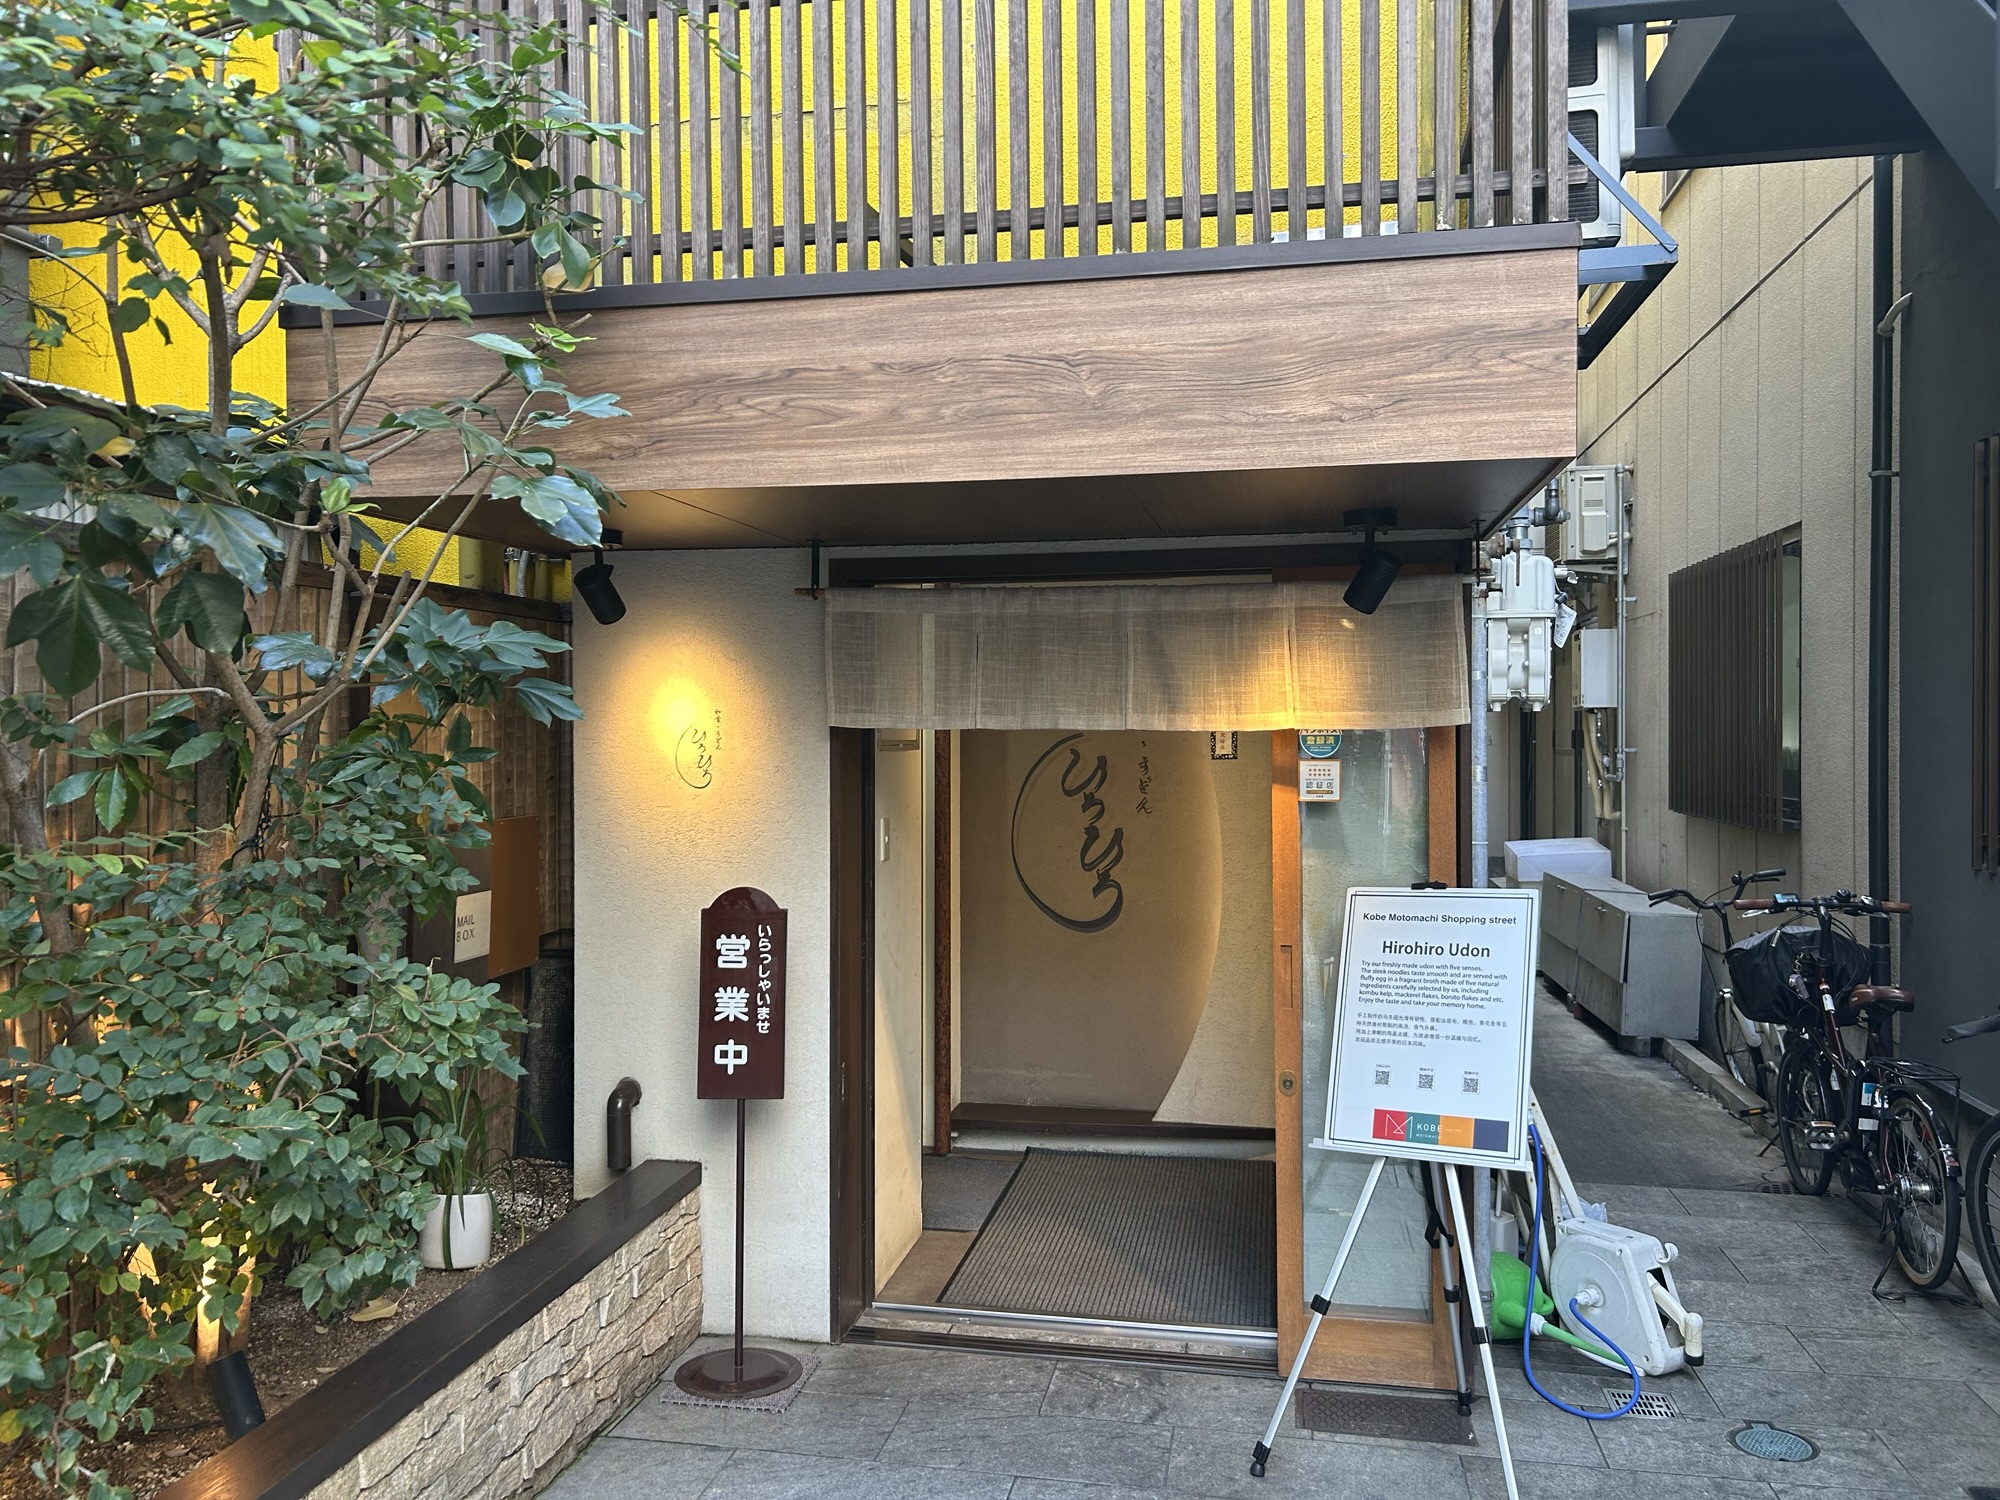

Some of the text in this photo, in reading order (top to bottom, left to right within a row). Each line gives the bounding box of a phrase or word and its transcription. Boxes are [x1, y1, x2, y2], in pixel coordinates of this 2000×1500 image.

[1305, 781, 1334, 790] 認証店
[456, 914, 475, 928] MAIL
[1363, 912, 1517, 925] Kobe Motomachi Shopping street
[456, 928, 475, 942] BOX
[1382, 940, 1490, 957] Hirohiro Udon
[756, 924, 772, 1034] いらっしゃいませ
[1361, 974, 1374, 982] fluffy
[1399, 976, 1422, 984] fragrant
[1461, 987, 1489, 995] including
[713, 933, 751, 1076] 営業中
[1358, 996, 1374, 1004] Enjoy
[1441, 1002, 1465, 1010] memory
[1416, 1123, 1442, 1132] KOBE
